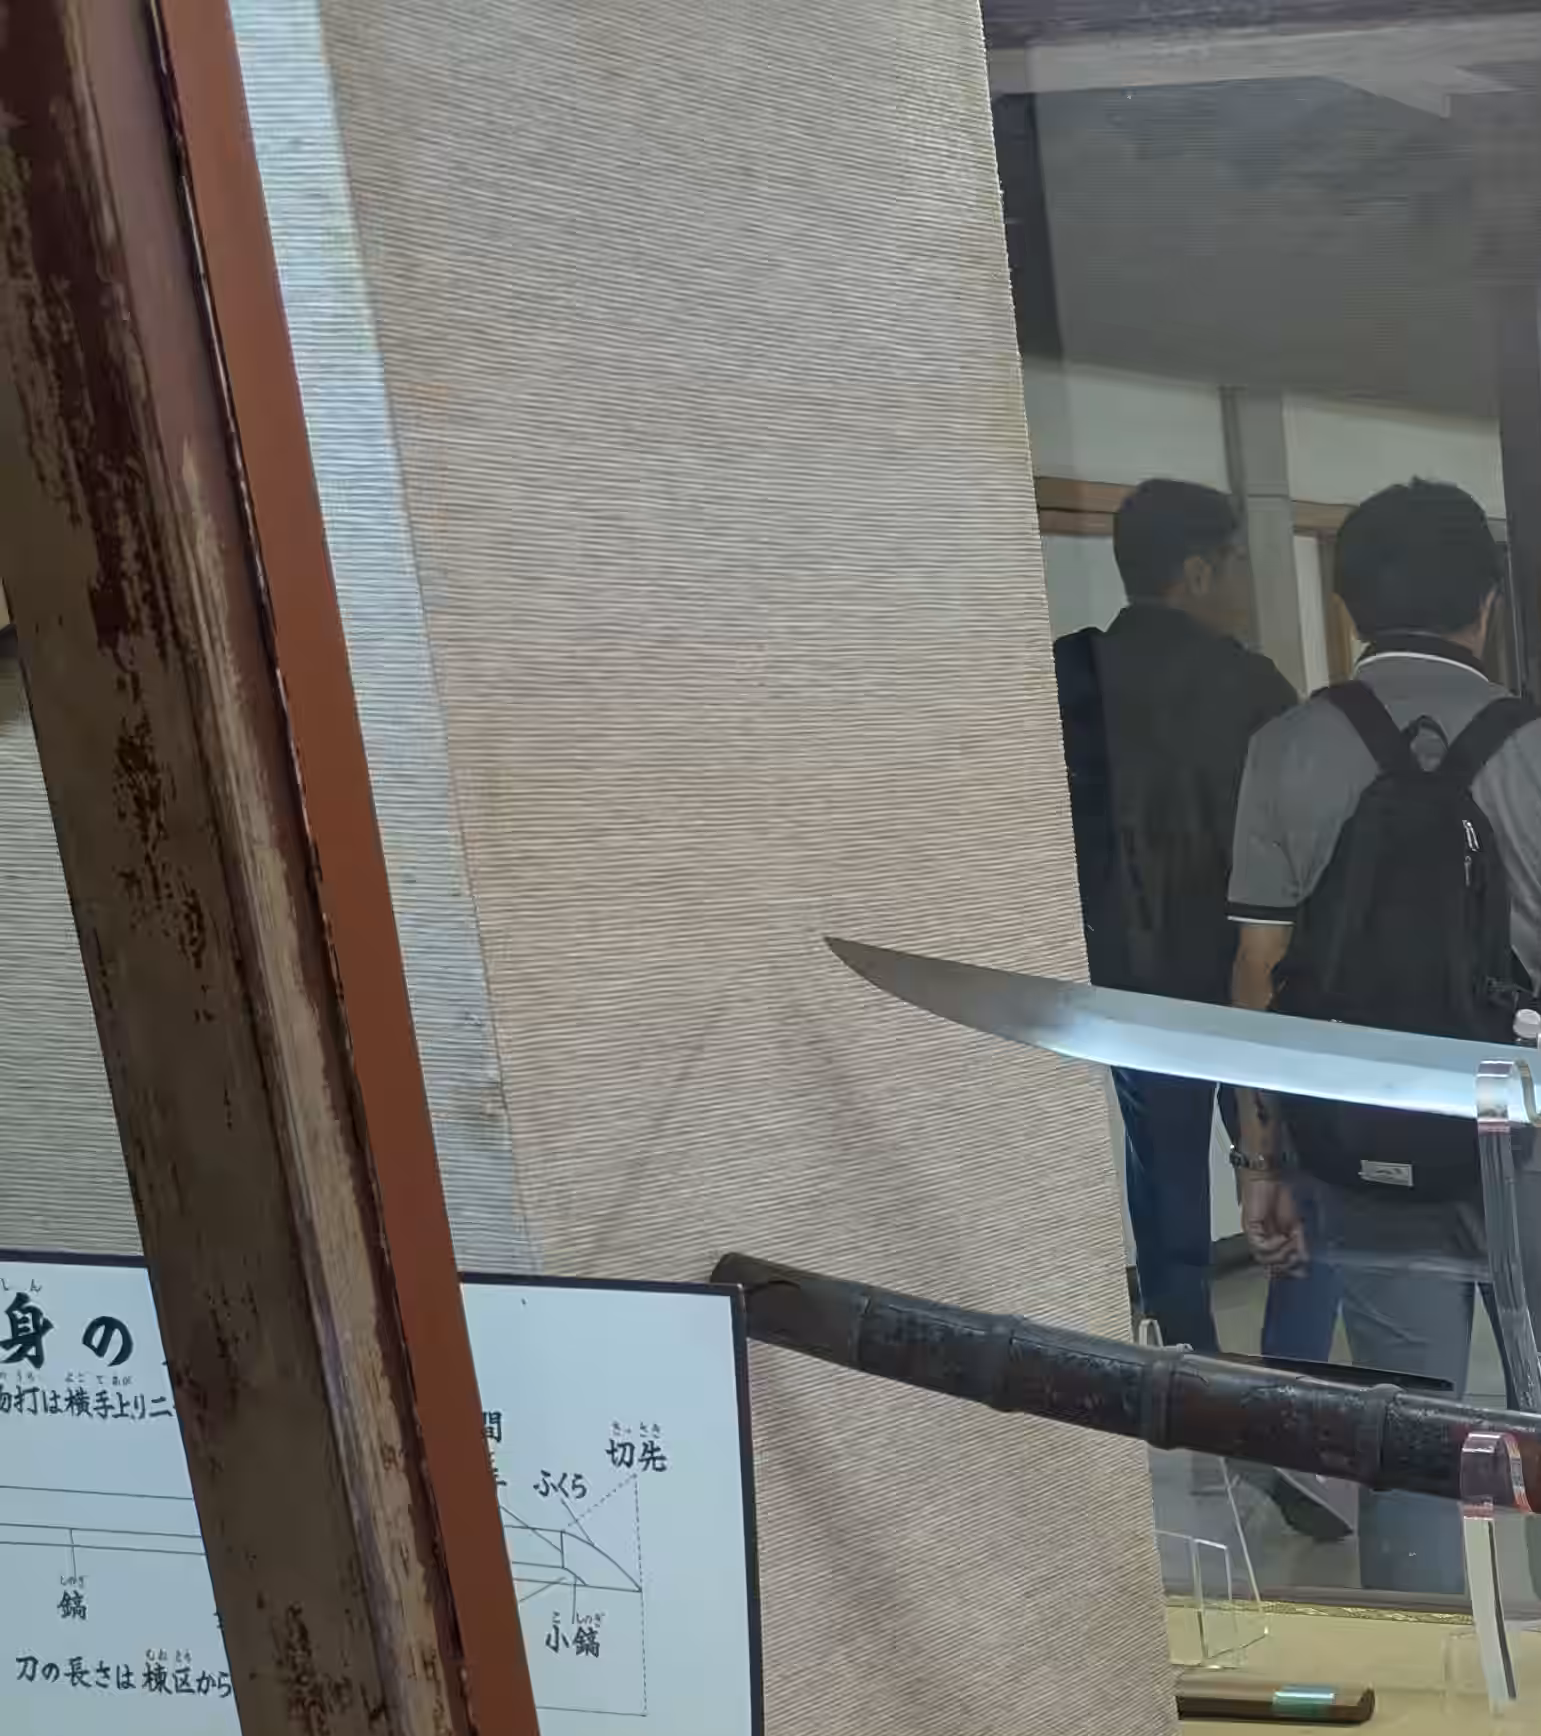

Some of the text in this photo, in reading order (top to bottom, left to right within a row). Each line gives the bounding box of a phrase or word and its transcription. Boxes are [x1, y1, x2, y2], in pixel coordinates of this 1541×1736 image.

[605, 1438, 668, 1473] 切先
[532, 1469, 588, 1500] ふくら
